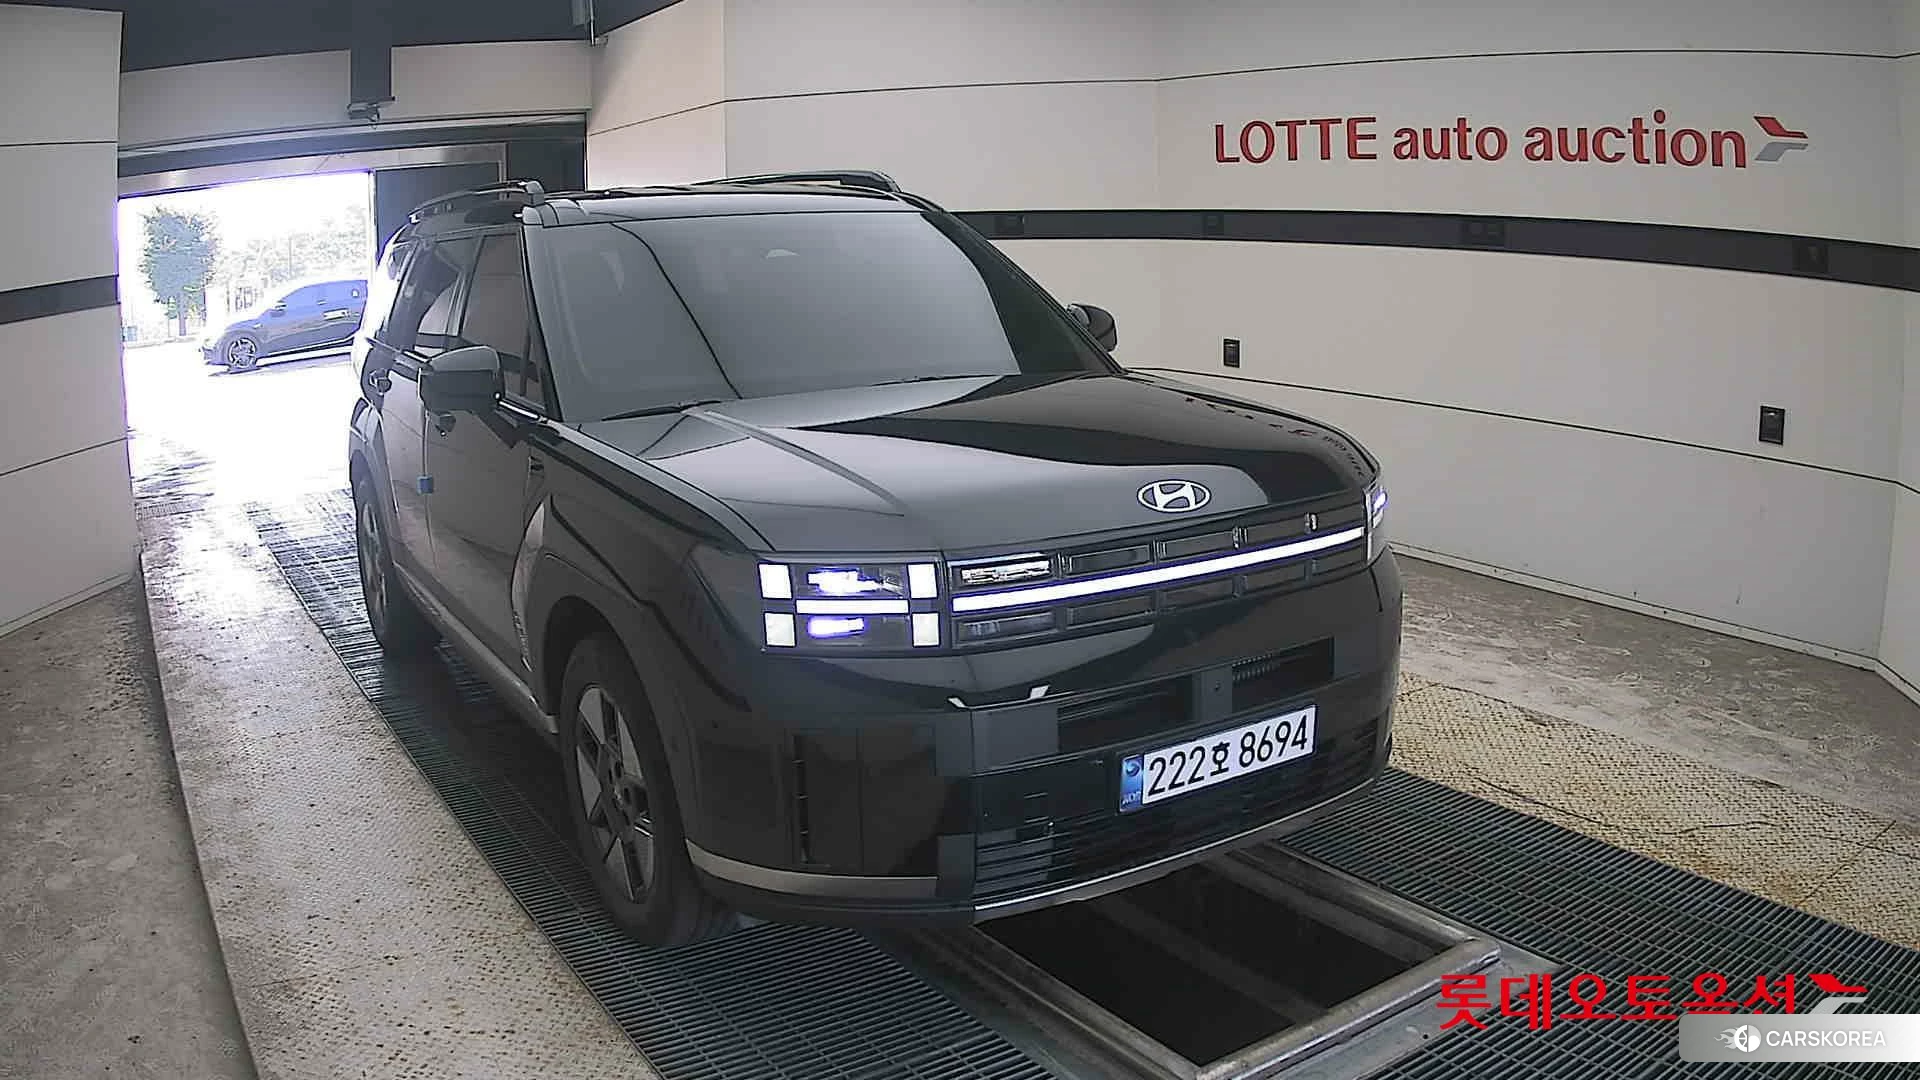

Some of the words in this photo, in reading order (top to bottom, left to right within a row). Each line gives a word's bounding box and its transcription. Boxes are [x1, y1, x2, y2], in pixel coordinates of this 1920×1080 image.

[1215, 116, 1377, 163] LOTTE
[1393, 117, 1508, 161] auto
[1524, 109, 1747, 169] auction
[1238, 714, 1308, 768] 8694
